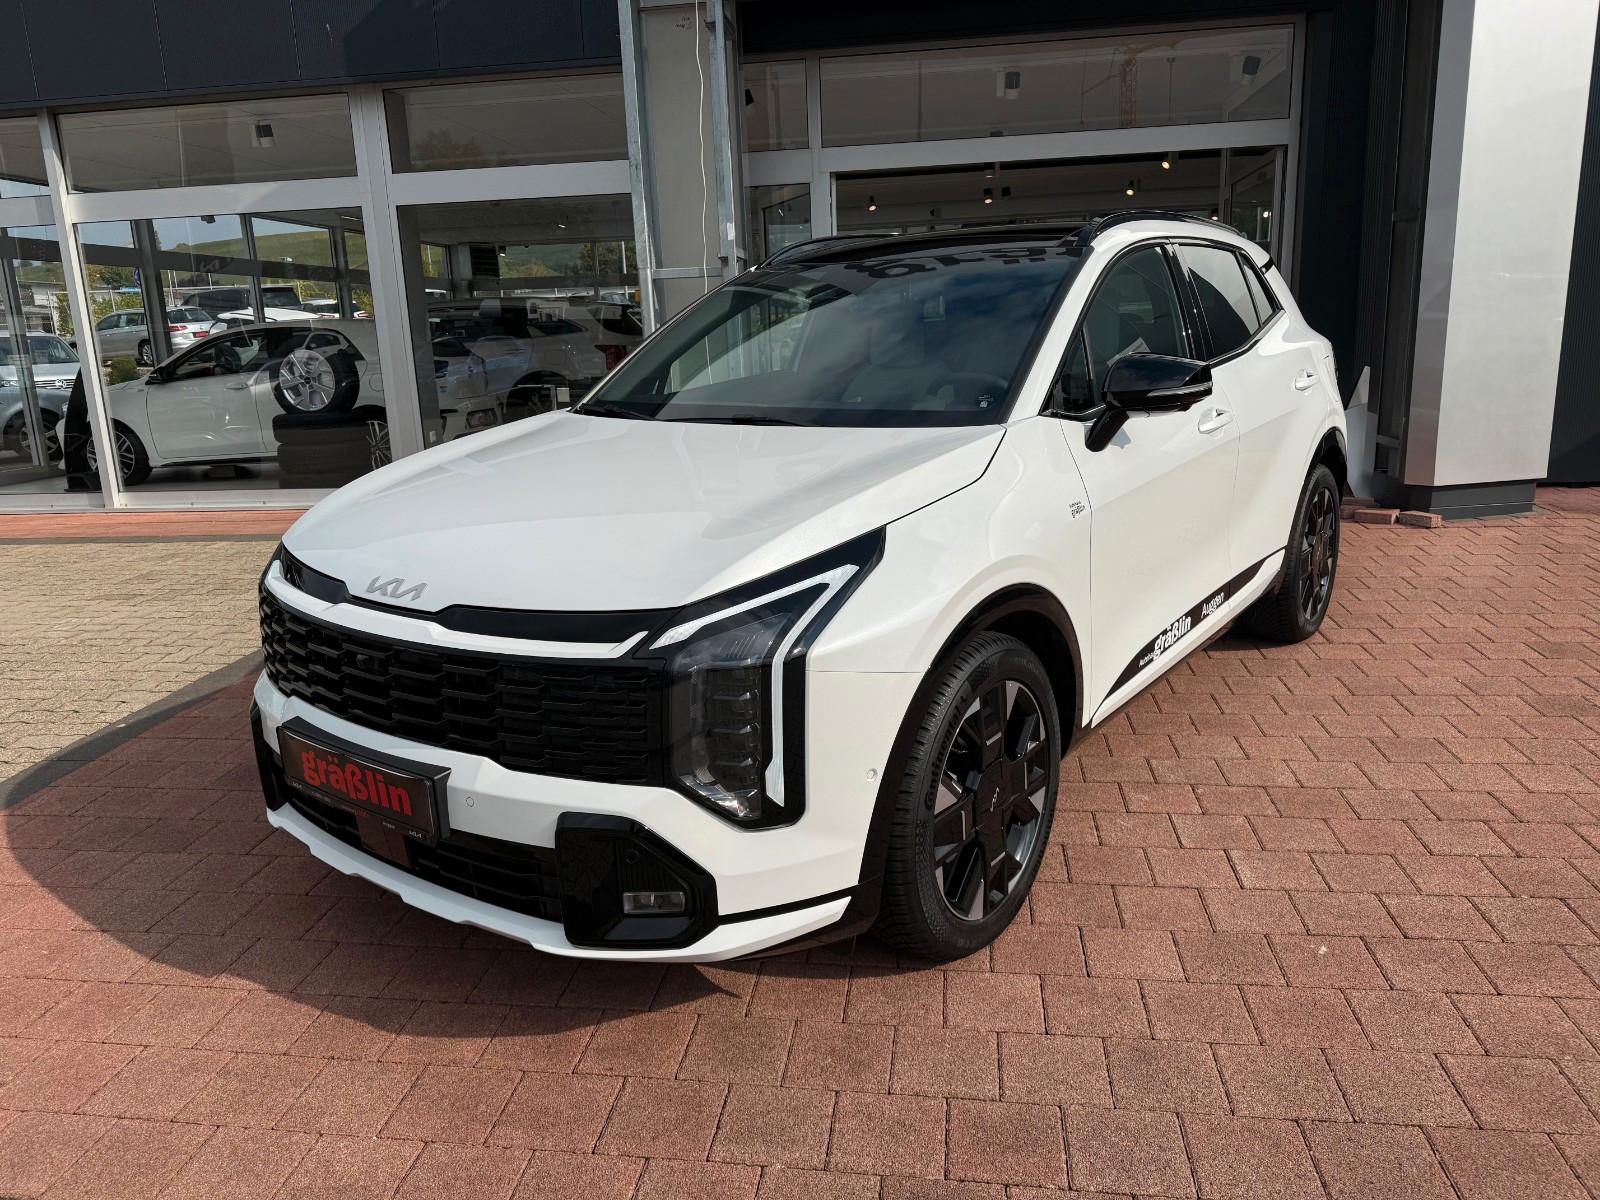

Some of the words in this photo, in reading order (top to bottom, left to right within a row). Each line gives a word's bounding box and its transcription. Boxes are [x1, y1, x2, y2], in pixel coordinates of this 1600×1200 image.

[366, 575, 428, 602] KIA
[1153, 615, 1192, 661] gräßlin
[1201, 591, 1225, 619] Auggen
[300, 750, 413, 816] gräßlin
